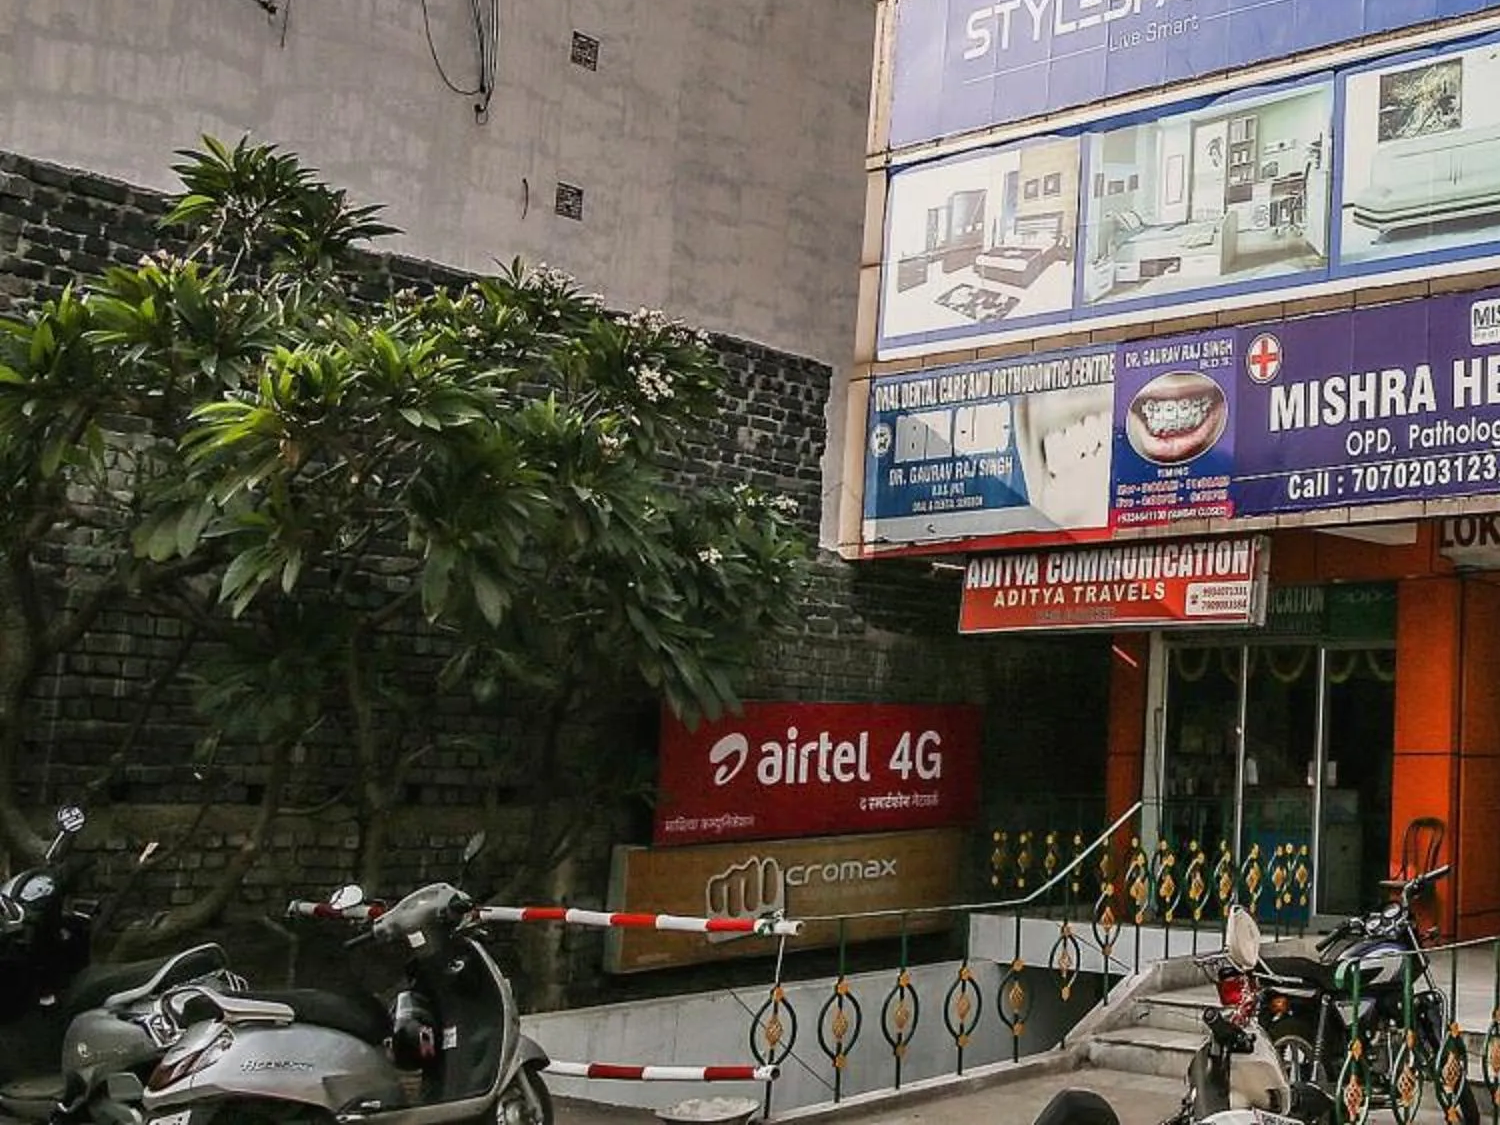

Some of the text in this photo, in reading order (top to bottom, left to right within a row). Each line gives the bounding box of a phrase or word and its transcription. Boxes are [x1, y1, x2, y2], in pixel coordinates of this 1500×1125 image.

[1109, 13, 1199, 52] Live Smart
[901, 378, 937, 408] DENTAL
[940, 374, 967, 403] CARE
[967, 370, 990, 399] AND
[1072, 353, 1115, 385] CENTRE
[1268, 365, 1437, 433] MISHRA
[1346, 430, 1398, 459] OPD,
[1287, 472, 1329, 501] Call
[966, 539, 1250, 590] ADITYA COMMUNICATION
[993, 581, 1166, 608] ADITYA TRAVELS
[757, 726, 941, 785] airtel 4G
